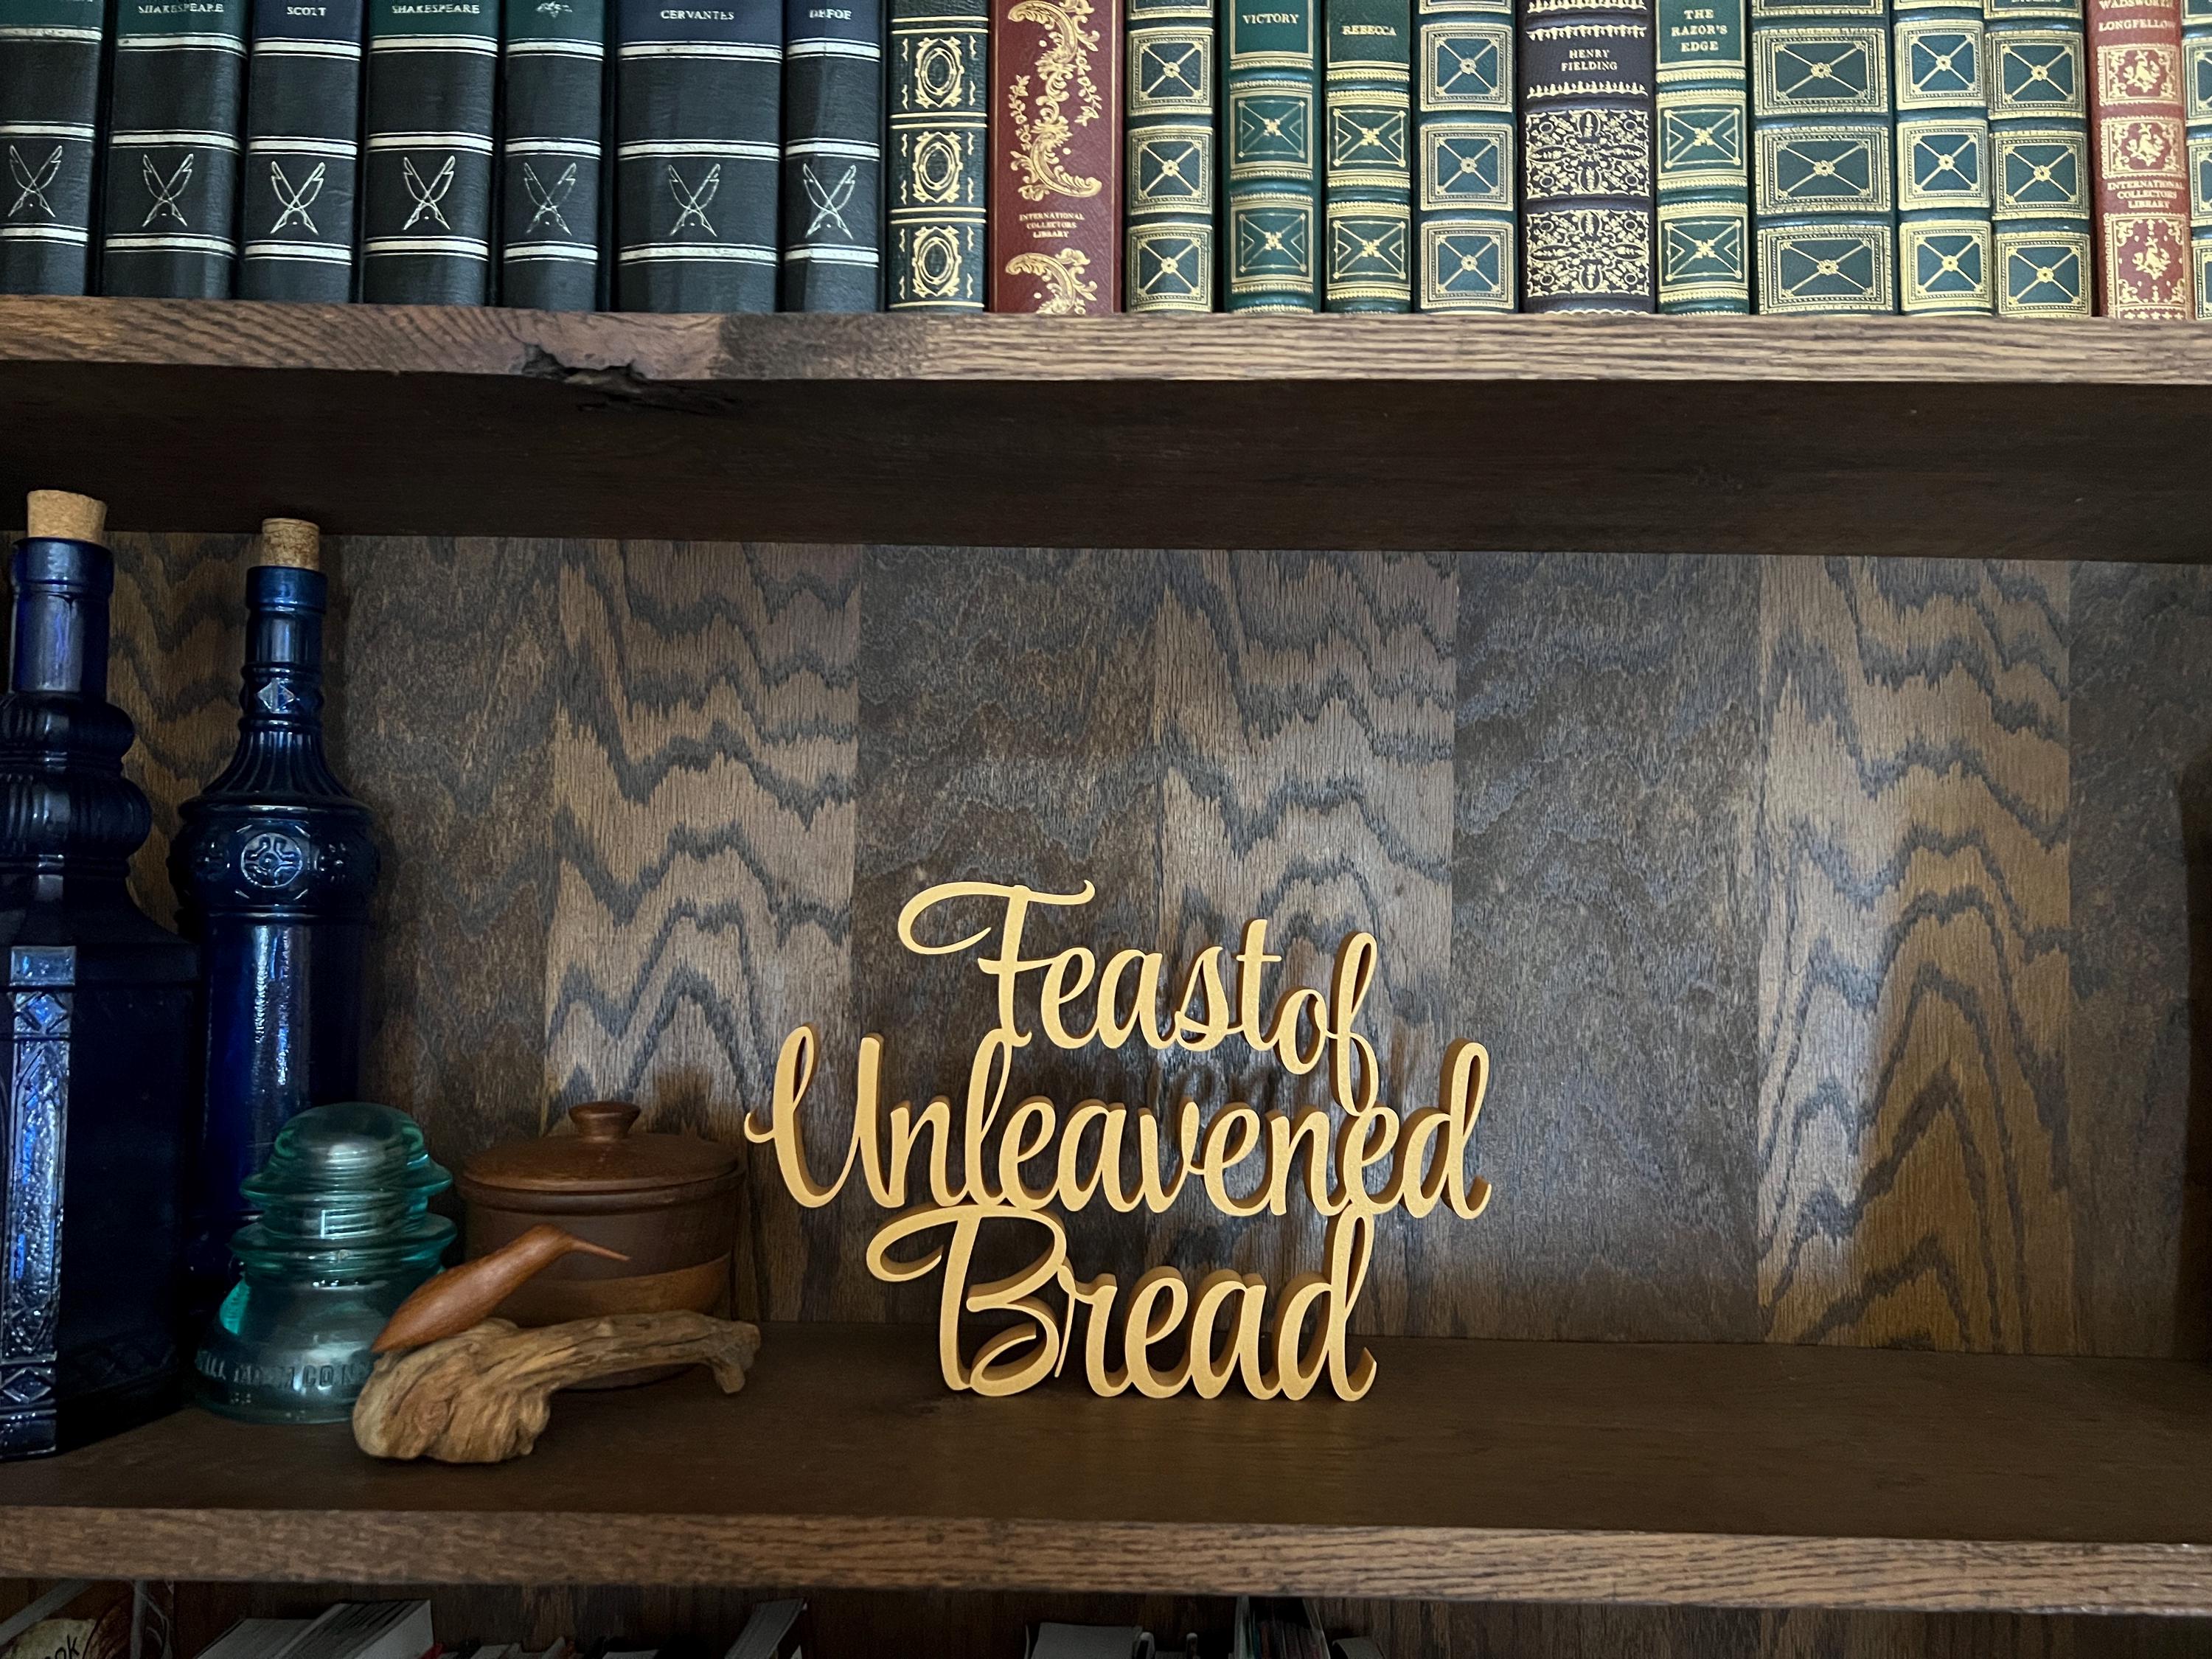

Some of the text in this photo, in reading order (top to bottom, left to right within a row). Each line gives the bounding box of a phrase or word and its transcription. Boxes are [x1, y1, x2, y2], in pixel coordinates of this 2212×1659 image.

[138, 3, 224, 14] SHAKESPEARE
[286, 6, 327, 17] SCOTT
[392, 4, 481, 14] SHAKESPEARE
[1683, 8, 1714, 20] THE
[660, 9, 735, 21] CERVANTES
[1242, 13, 1299, 24] VICTORY
[1341, 24, 1397, 36] REBECCA
[1670, 24, 1728, 37] RAZOR'S
[2098, 18, 2176, 32] LONGFELLOW
[1680, 41, 1719, 52] EDGE
[1568, 49, 1610, 60] HENRY
[1560, 60, 1618, 72] FIELDING
[2107, 179, 2185, 190] INTERNATIONAL
[2117, 189, 2177, 200] COLLECTORS
[2128, 200, 2171, 209] LIBRARY
[1018, 211, 1085, 221] INTERNATIONAL
[1026, 221, 1078, 230] COLLECTORS
[1032, 230, 1069, 239] LIBRARY
[897, 879, 1379, 1117] Feast of
[744, 1024, 1494, 1220] Unleavened
[866, 1200, 1379, 1402] Bread
